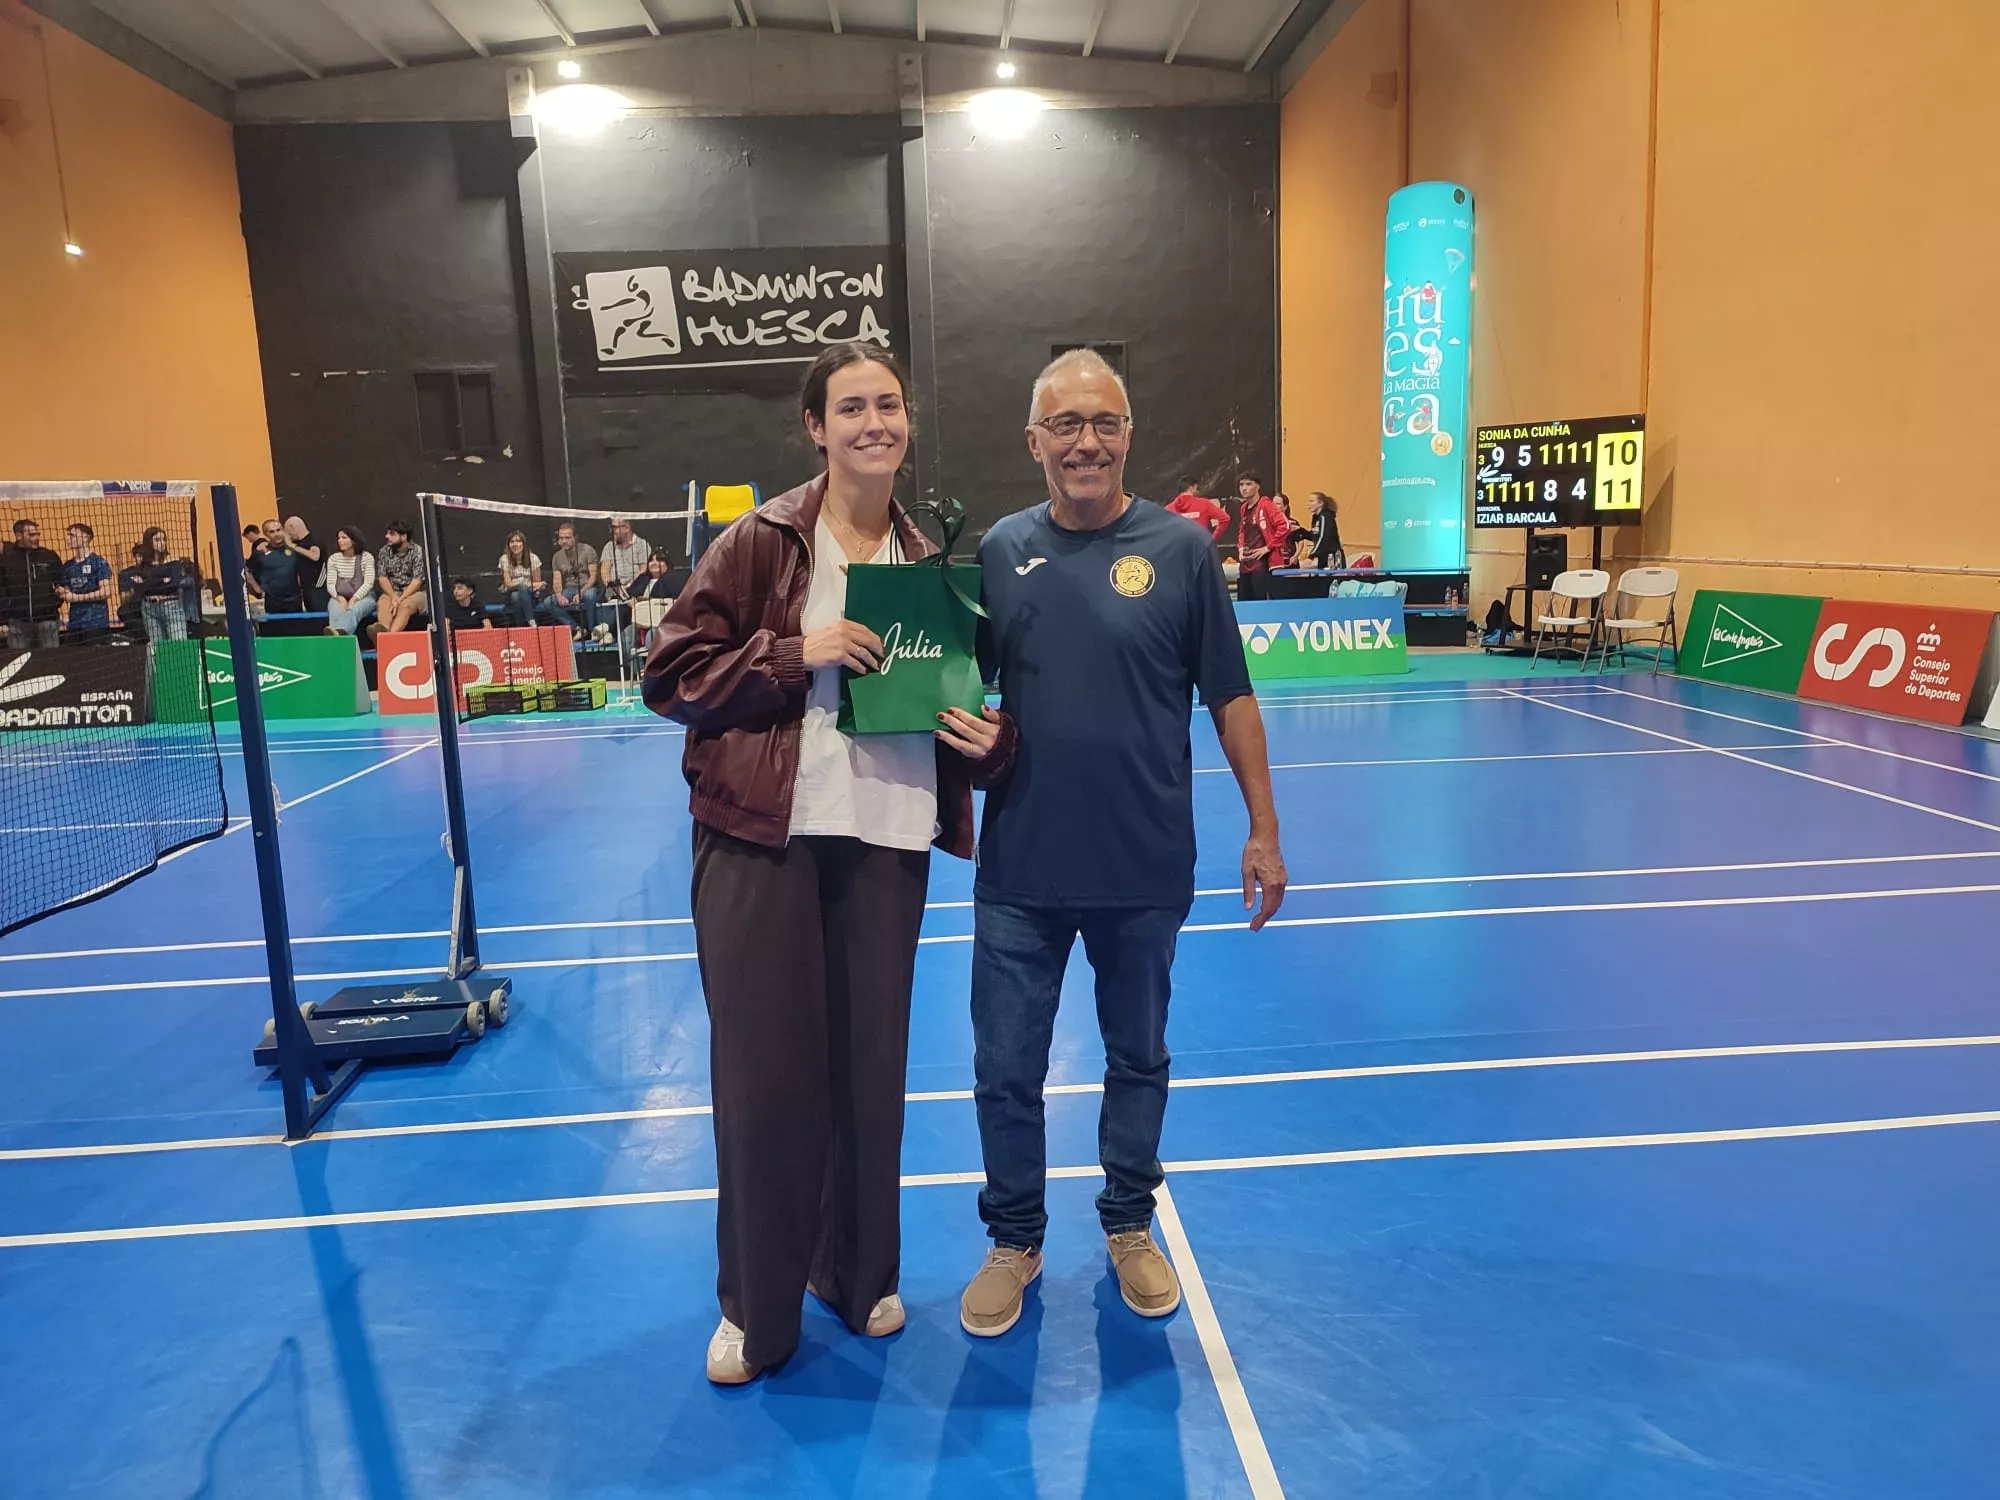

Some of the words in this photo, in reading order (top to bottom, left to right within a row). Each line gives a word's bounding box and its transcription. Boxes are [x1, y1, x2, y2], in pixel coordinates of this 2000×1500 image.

[686, 305, 891, 348] HUESCA
[1479, 429, 1511, 441] SONIA
[1514, 428, 1528, 439] DA
[1531, 425, 1571, 438] CUNHA
[1478, 454, 1485, 465] 3
[1492, 446, 1504, 467] 9
[1518, 445, 1531, 466] 5
[1604, 440, 1637, 466] 10
[1477, 490, 1484, 500] 3
[1544, 480, 1557, 501] 8
[1572, 478, 1586, 500] 4
[1603, 478, 1632, 503] 11
[1477, 513, 1504, 524] IZIAR
[1506, 512, 1557, 523] BARCALA
[1289, 618, 1393, 652] YONEX
[881, 622, 943, 676] Júlia
[504, 665, 543, 676] Consejo
[1913, 656, 1950, 676] Consejo
[1909, 669, 1949, 685] Superior
[80, 689, 133, 702] ESPAÑA
[1905, 683, 1917, 694] de
[1918, 685, 1961, 702] Deportes
